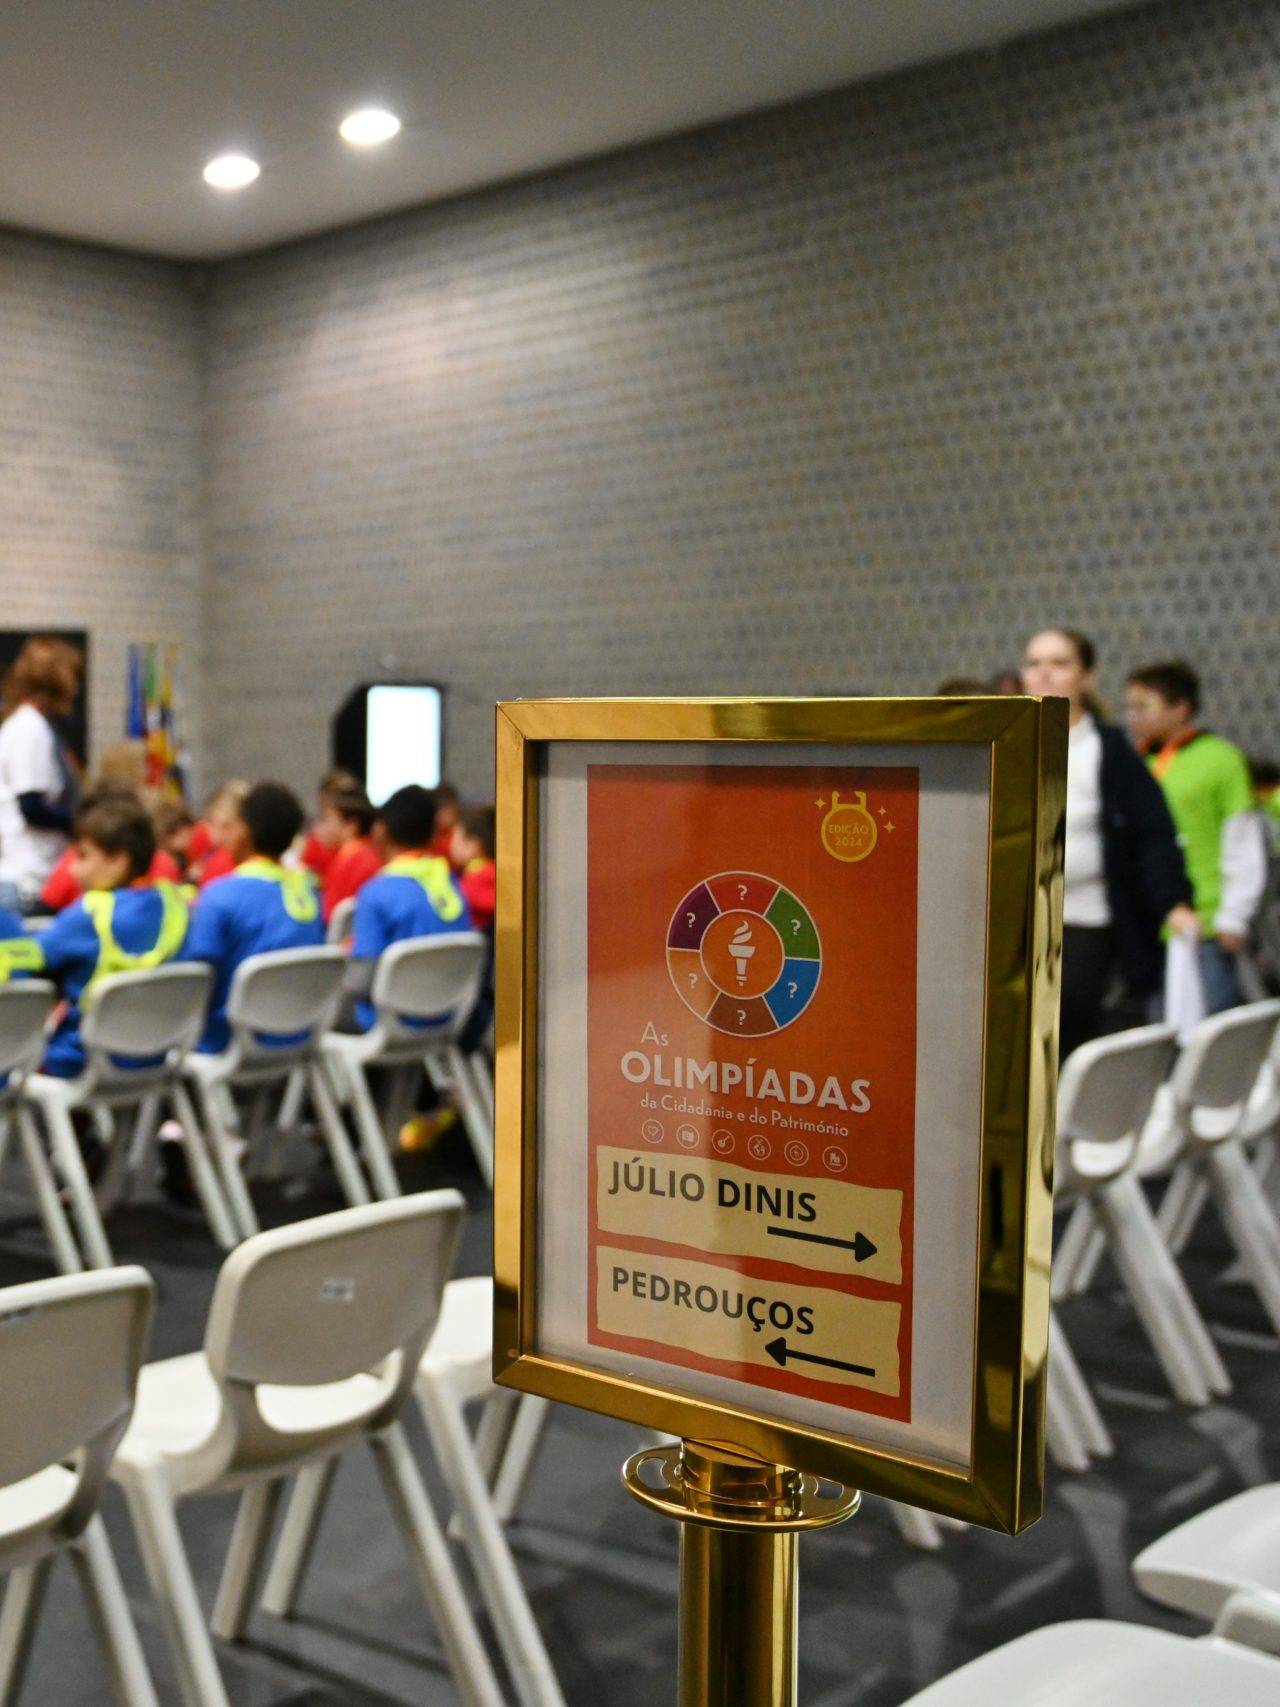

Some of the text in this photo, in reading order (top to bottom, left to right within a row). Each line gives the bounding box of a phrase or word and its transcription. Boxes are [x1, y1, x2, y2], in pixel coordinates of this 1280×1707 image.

[829, 823, 869, 835] EDIÇÃO
[640, 1021, 669, 1046] As
[620, 1050, 872, 1114] OLIMPÍADAS
[640, 1092, 850, 1138] da Cidadania e do Património
[607, 1157, 818, 1223] JÚLIO DINIS
[612, 1266, 815, 1336] PEDROUÇOS
